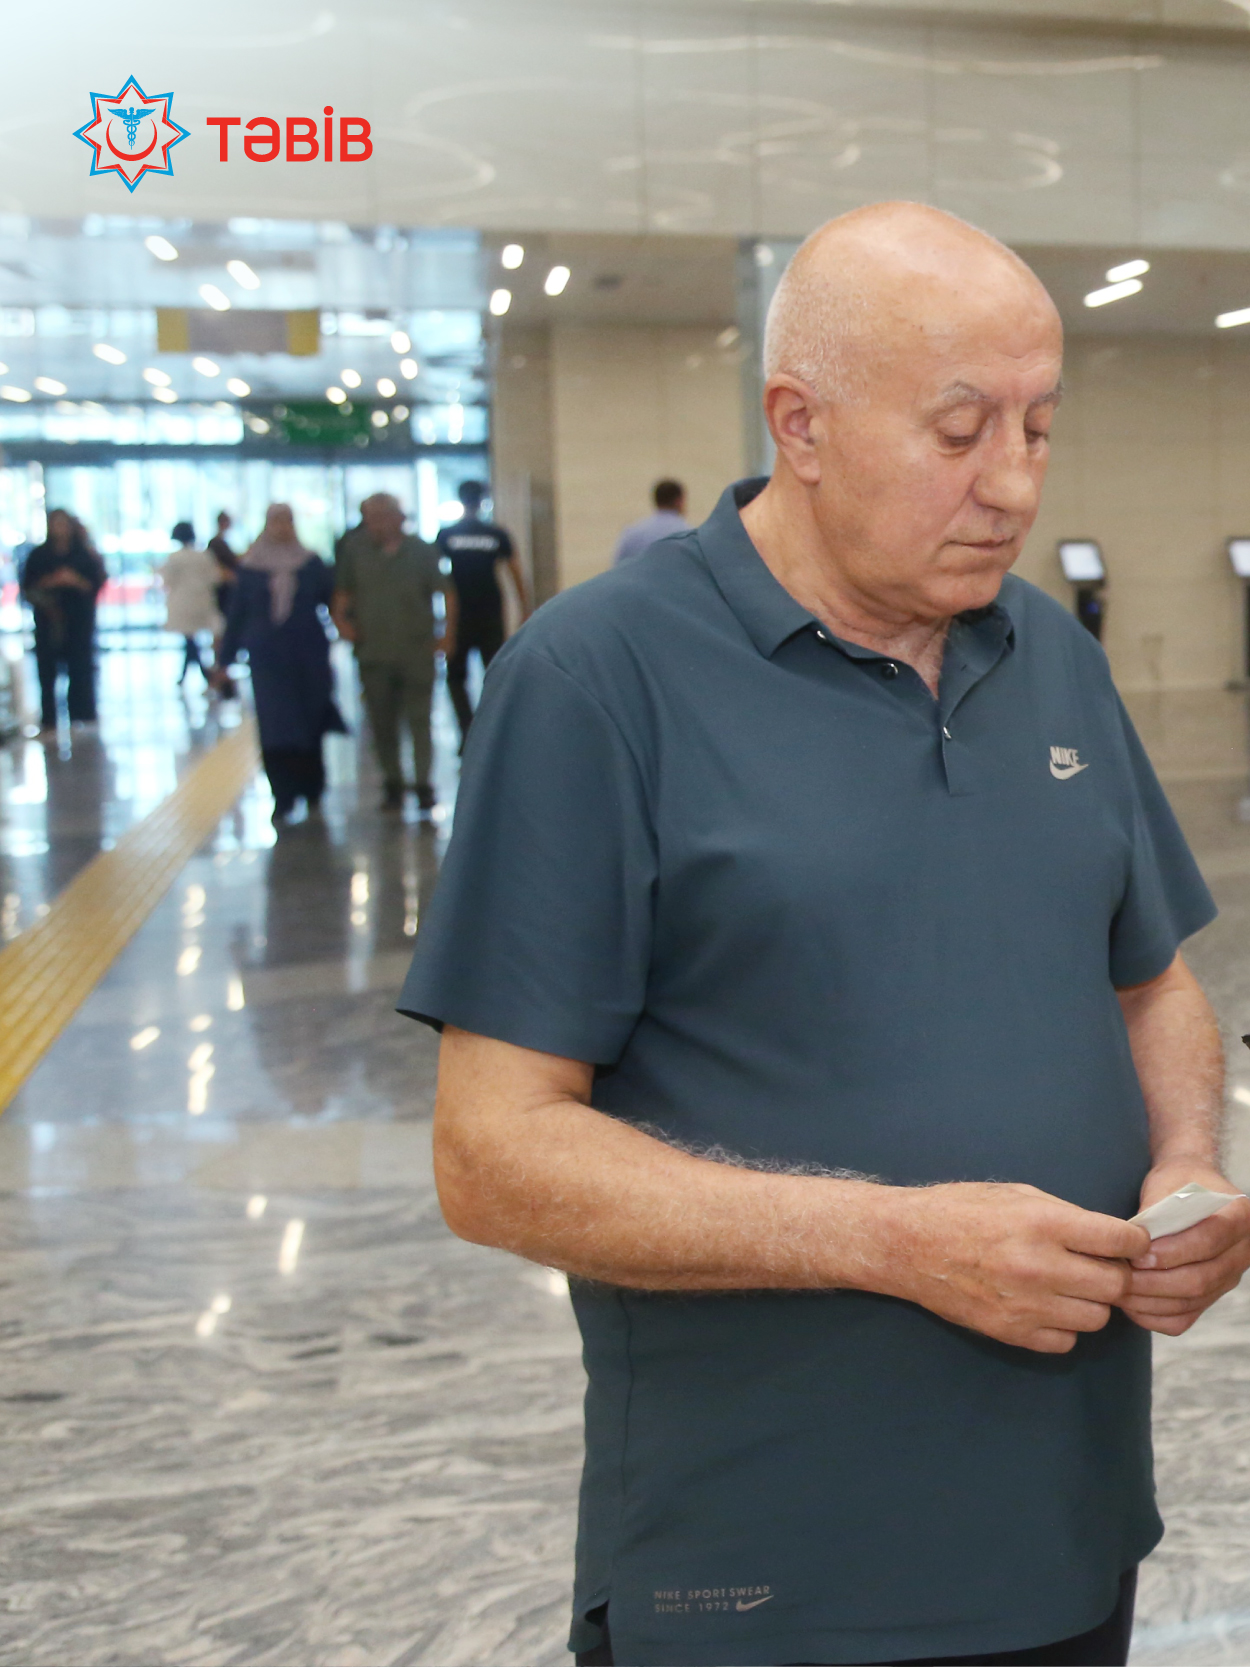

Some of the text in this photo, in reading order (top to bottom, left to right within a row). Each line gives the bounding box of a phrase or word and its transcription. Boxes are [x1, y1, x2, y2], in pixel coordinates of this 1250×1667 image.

[1050, 746, 1080, 767] NIKE
[654, 1590, 681, 1600] NIKE
[654, 1601, 729, 1613] SINCE 1972
